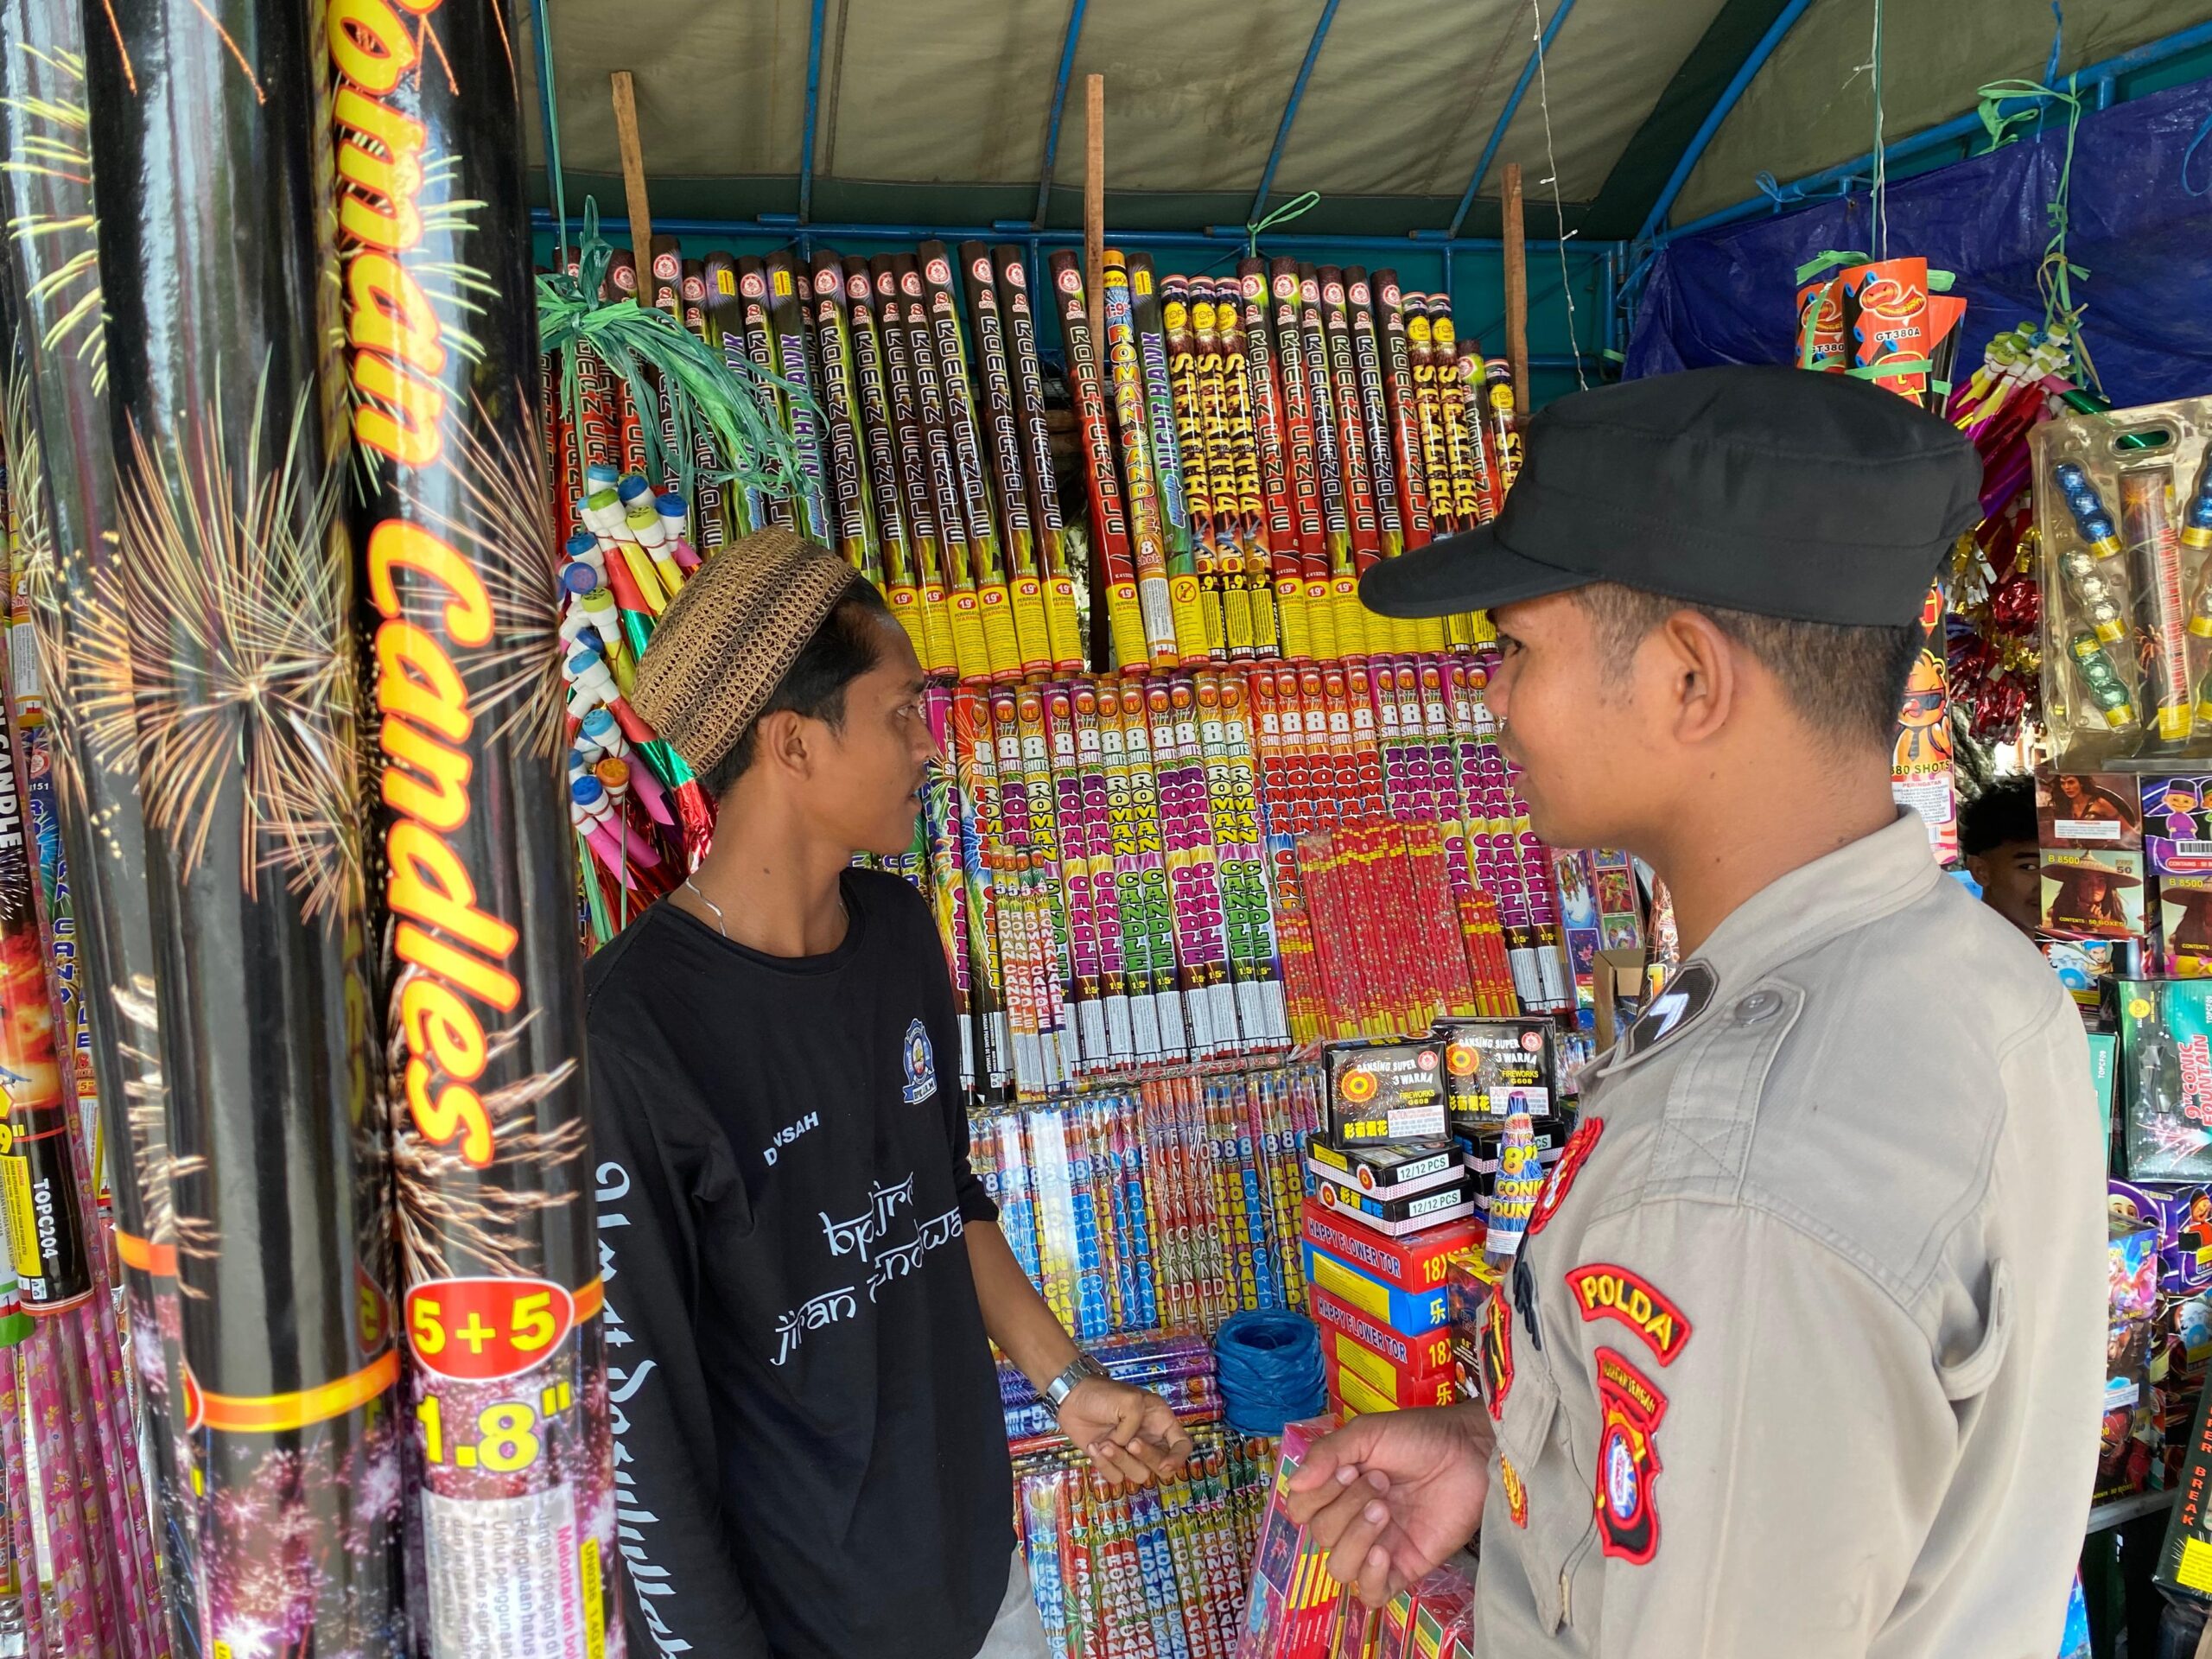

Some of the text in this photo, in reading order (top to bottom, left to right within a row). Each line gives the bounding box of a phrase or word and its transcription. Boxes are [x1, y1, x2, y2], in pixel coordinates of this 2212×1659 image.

[1108, 325, 1144, 424] ROMAN
[1875, 327, 1921, 342] GT380A
[820, 326, 863, 538] ROMAN CANDLE
[854, 331, 902, 540] ROMAN CANDLE
[885, 328, 935, 538] ROMAN CANDLE
[911, 329, 966, 543] ROMAN CANDLE
[935, 319, 992, 538] ROMAN CANDLE
[981, 315, 1030, 530] ROMAN CANDLE
[1014, 320, 1063, 530] ROMAN CANDLE
[1070, 326, 1125, 535] ROMAN CANDLE
[1141, 331, 1180, 471] NIGHT HAWK
[1248, 330, 1290, 532] ROMAN CANDLE
[1280, 330, 1319, 534] ROMAN CANDLE
[1306, 334, 1345, 532] ROMAN CANDLE
[1332, 336, 1374, 531] ROMAN CANDLE
[1357, 336, 1399, 531] ROMAN CANDLE
[1392, 337, 1430, 531] ROMAN CANDLE
[1122, 429, 1159, 536] CANDLE
[1141, 539, 1154, 553] 8
[1023, 736, 1045, 759] 8
[1056, 734, 1075, 755] 8
[1079, 729, 1100, 750] 8
[1101, 731, 1122, 753] 8
[1126, 728, 1147, 749] 8
[1202, 721, 1224, 743] 8
[1281, 712, 1302, 733] 8
[1305, 709, 1325, 732] 8
[1023, 760, 1049, 772] SHOTS
[1207, 765, 1238, 845] ROMAN
[1285, 754, 1317, 834] ROMAN
[1430, 745, 1461, 823] ROMAN
[1914, 760, 1951, 774] SHOTS
[368, 520, 519, 1168] Candles
[1129, 772, 1161, 854] ROMAN
[1477, 744, 1529, 928] ROMAN CANDLE
[1058, 779, 1100, 977] ROMAN CANDLE
[1081, 774, 1124, 973] ROMAN CANDLE
[1106, 777, 1147, 973] ROMAN CANDLE
[1158, 772, 1203, 966] ROMAN CANDLE
[1180, 766, 1224, 961] ROMAN CANDLE
[1230, 766, 1273, 959] ROMAN CANDLE
[2049, 855, 2055, 863] B
[2116, 866, 2133, 874] 50
[1141, 868, 1174, 969] CANDLE
[1219, 859, 1252, 959] CANDLE
[1393, 1058, 1416, 1071] SUPER
[1393, 1072, 1433, 1085] 3 WARNA
[1494, 1037, 1520, 1049] SUPER
[1495, 1052, 1536, 1065] 3 WARNA
[1502, 1069, 1539, 1078] FIREWORKS
[2192, 1034, 2212, 1128] FOUNTAIN
[1400, 1089, 1435, 1100] FIREWORKS
[1400, 1157, 1446, 1179] 12/12 PCS
[1535, 1136, 1549, 1149] CS
[34, 1177, 59, 1259] TOPC204
[1411, 1192, 1459, 1214] 12/12 PCS
[1307, 1218, 1401, 1278] HAPPY FLOWER TOR
[413, 1301, 448, 1355] 5
[510, 1292, 556, 1349] 5
[1317, 1297, 1407, 1363] HAPPY FLOWER TOR
[1430, 1298, 1446, 1325] 乐
[1580, 1274, 1674, 1351] POLDA
[416, 1382, 572, 1472] 1.8"
[1436, 1381, 1452, 1407] 乐
[2182, 1465, 2206, 1527] BREAK
[472, 1521, 489, 1598] Tanamkan
[492, 1520, 510, 1563] Untuk
[512, 1517, 537, 1656] Penggunaan harus
[536, 1513, 560, 1654] Jangan dipegang di
